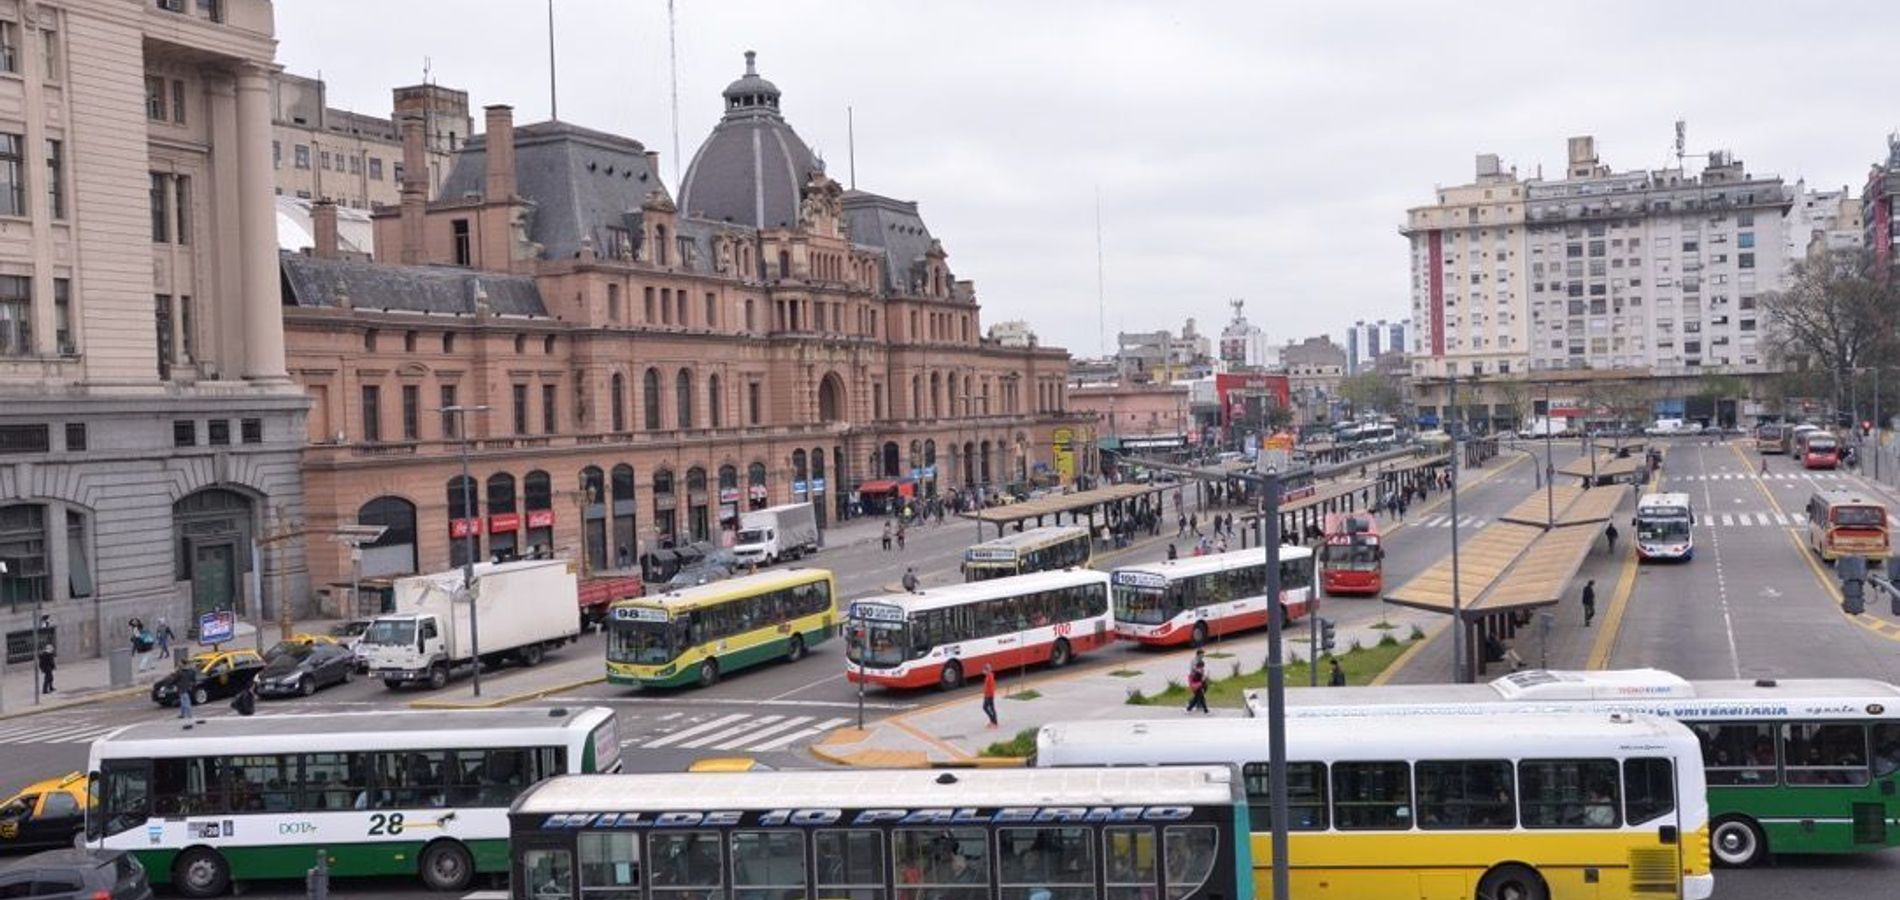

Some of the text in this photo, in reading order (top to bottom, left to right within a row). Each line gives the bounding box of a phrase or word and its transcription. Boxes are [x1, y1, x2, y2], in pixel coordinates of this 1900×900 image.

[1121, 574, 1137, 584] 100
[618, 608, 639, 618] 98
[1053, 624, 1072, 637] 100
[541, 806, 1194, 828] WILDE 10 PALERMO
[368, 813, 404, 836] 28
